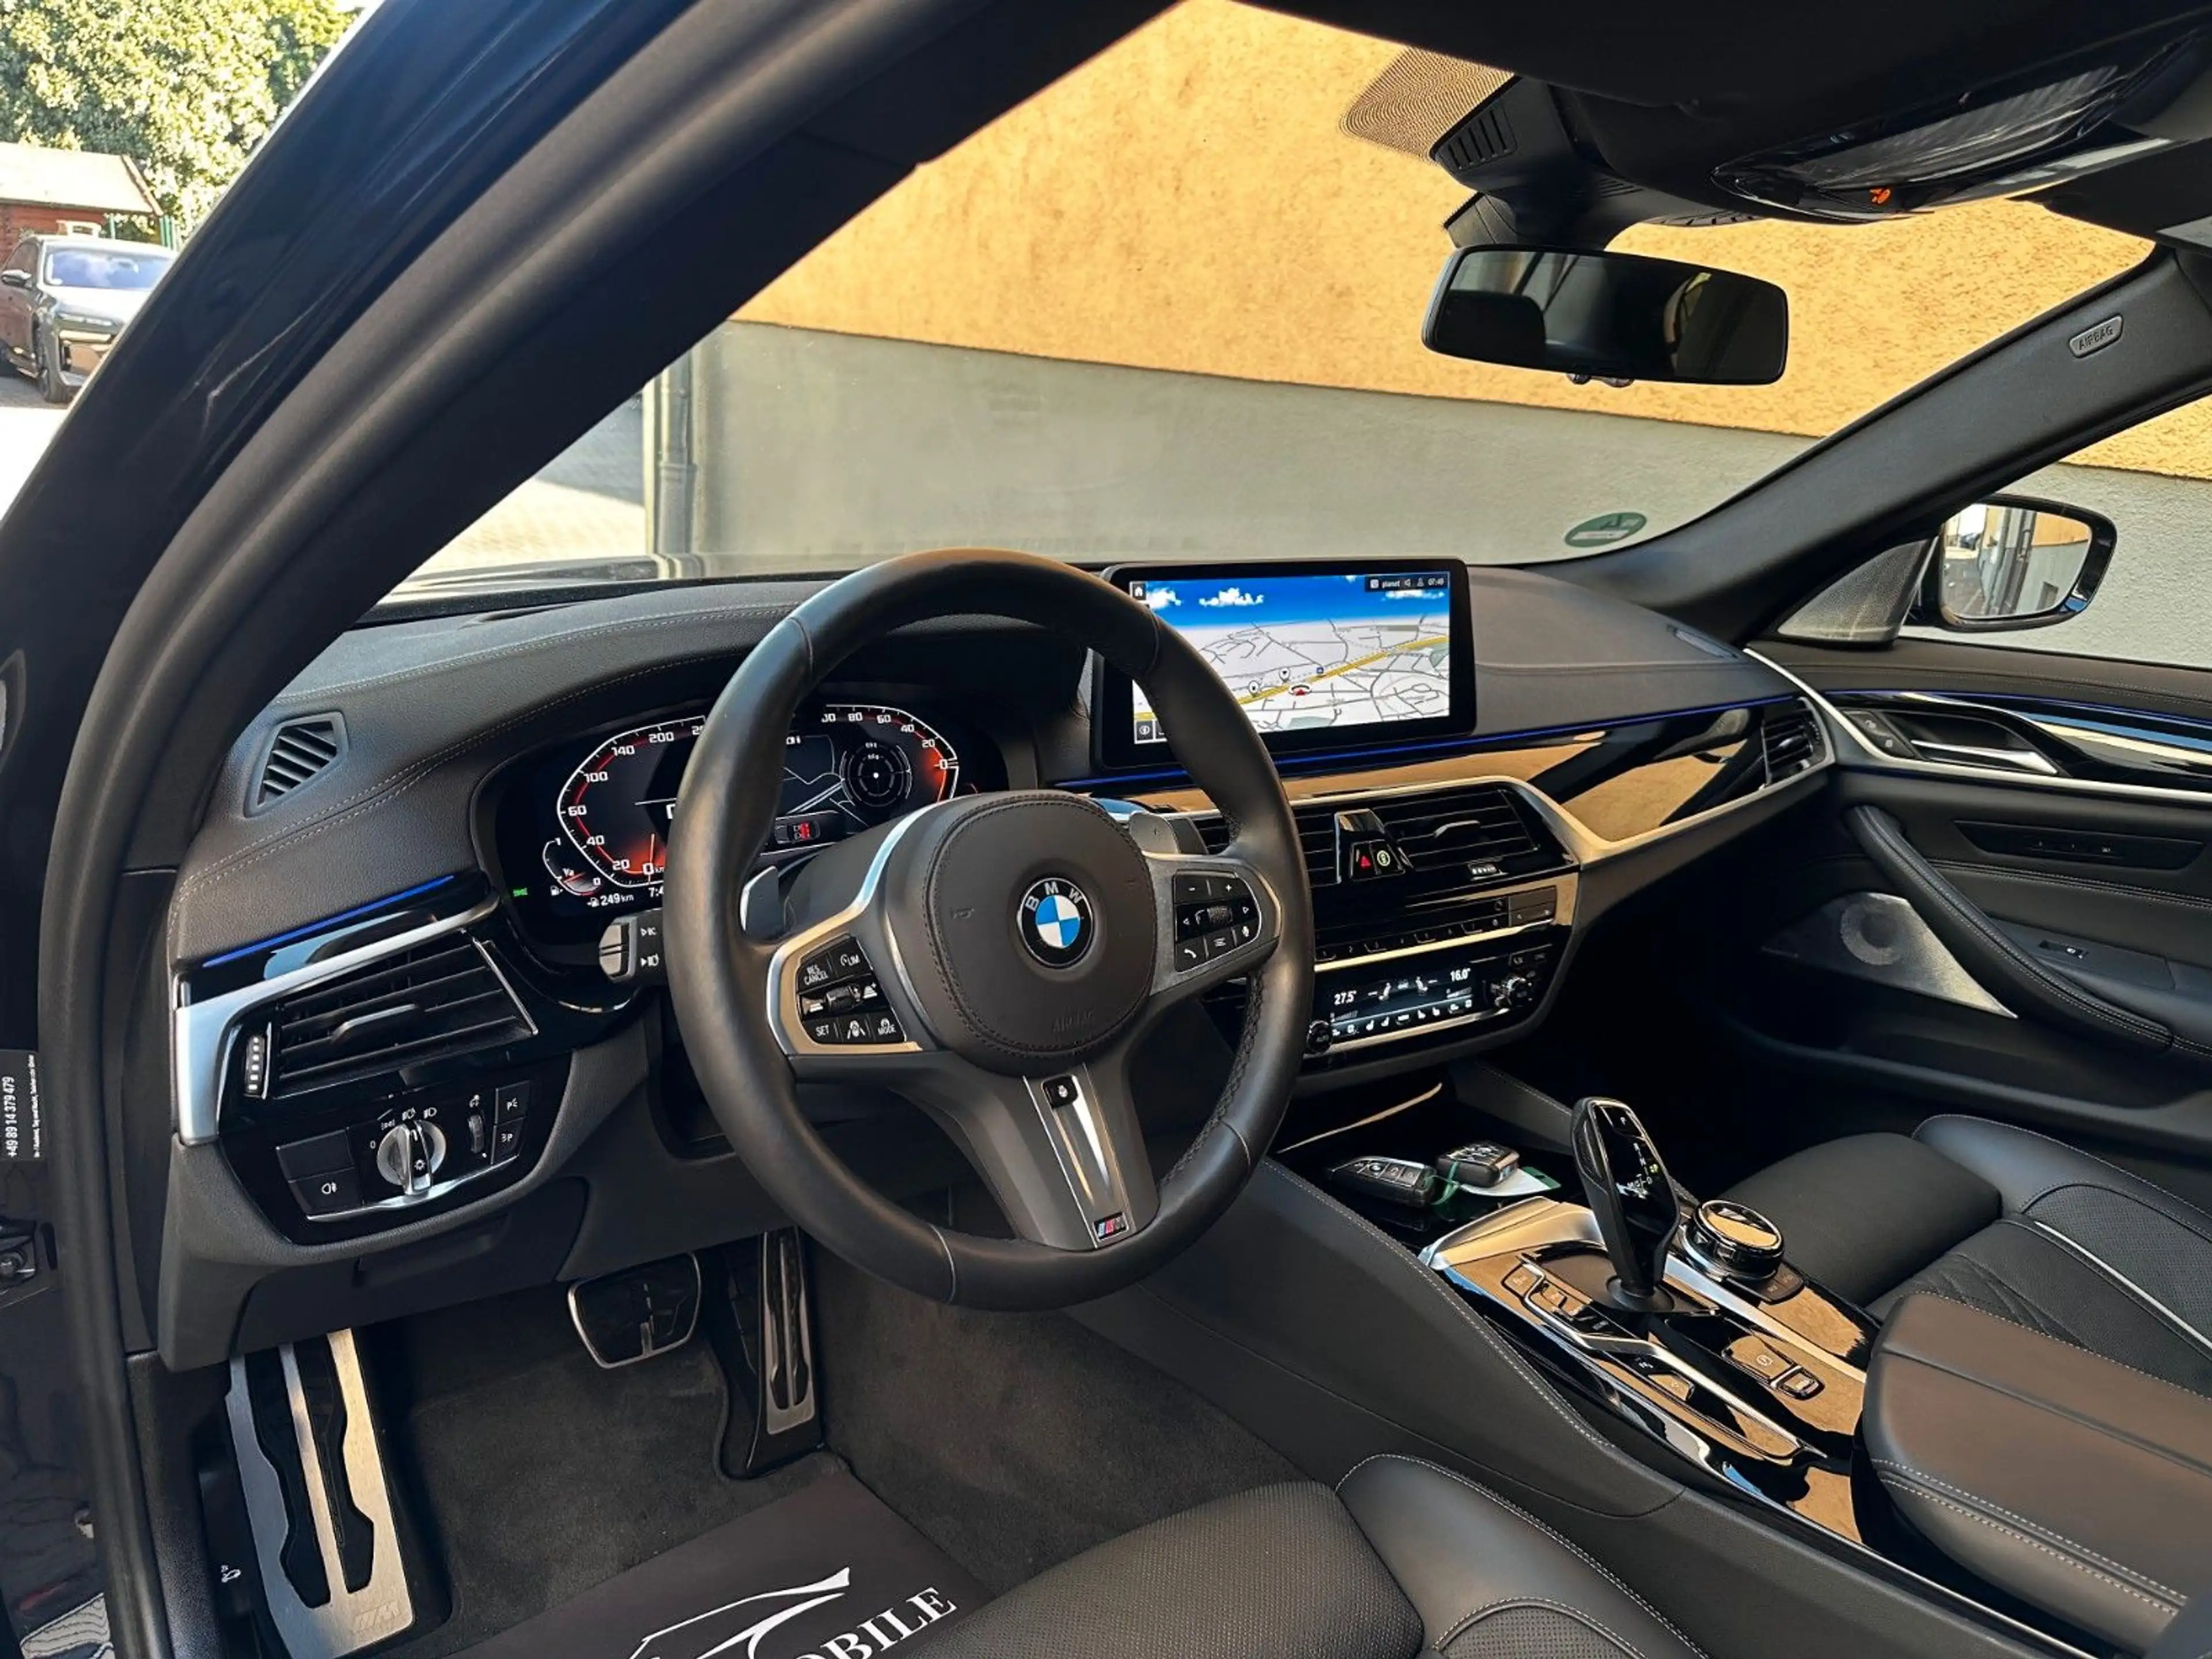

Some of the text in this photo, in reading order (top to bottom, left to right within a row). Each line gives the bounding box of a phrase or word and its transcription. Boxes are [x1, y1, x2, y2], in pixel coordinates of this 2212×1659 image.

[847, 712, 863, 722] 80
[876, 714, 892, 724] 60
[900, 724, 915, 733] 40
[648, 731, 675, 744] 200
[922, 738, 935, 748] 20
[611, 745, 635, 757] 140
[584, 771, 609, 783] 100
[567, 804, 588, 817] 60
[586, 835, 605, 846] 40
[612, 859, 630, 871] 20
[642, 862, 654, 875] 0
[593, 877, 601, 886] 0
[600, 893, 634, 906] 249 km
[1024, 881, 1083, 912] BMW
[804, 970, 830, 986] CANCEL
[815, 1024, 830, 1037] SET
[5, 1126, 18, 1139] 89
[5, 1139, 18, 1158] +49
